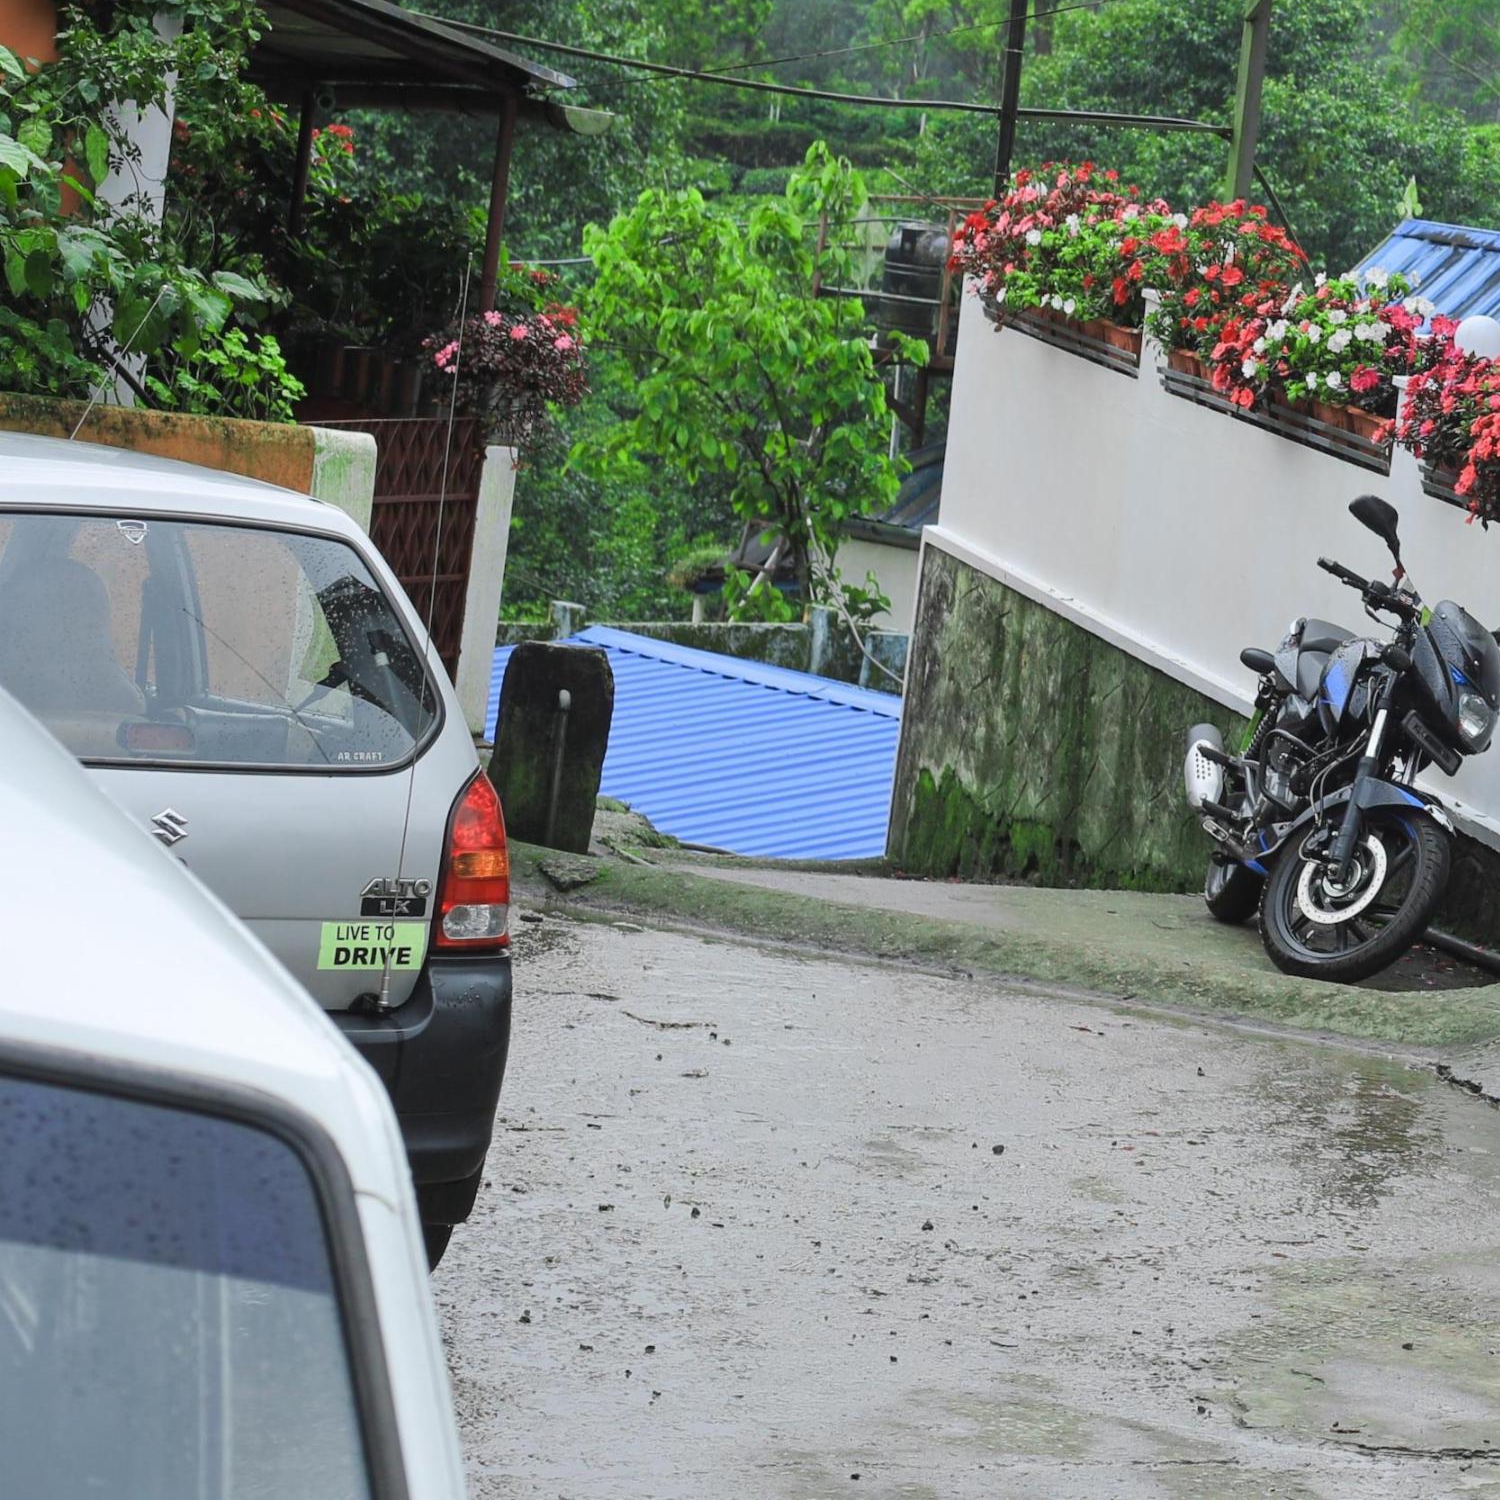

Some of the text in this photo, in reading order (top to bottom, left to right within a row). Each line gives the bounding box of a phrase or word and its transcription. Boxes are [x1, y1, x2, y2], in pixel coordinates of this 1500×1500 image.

[360, 878, 432, 898] ALTO
[379, 900, 411, 914] LX
[336, 925, 395, 942] LIVE TO
[333, 946, 412, 966] DRIVE
